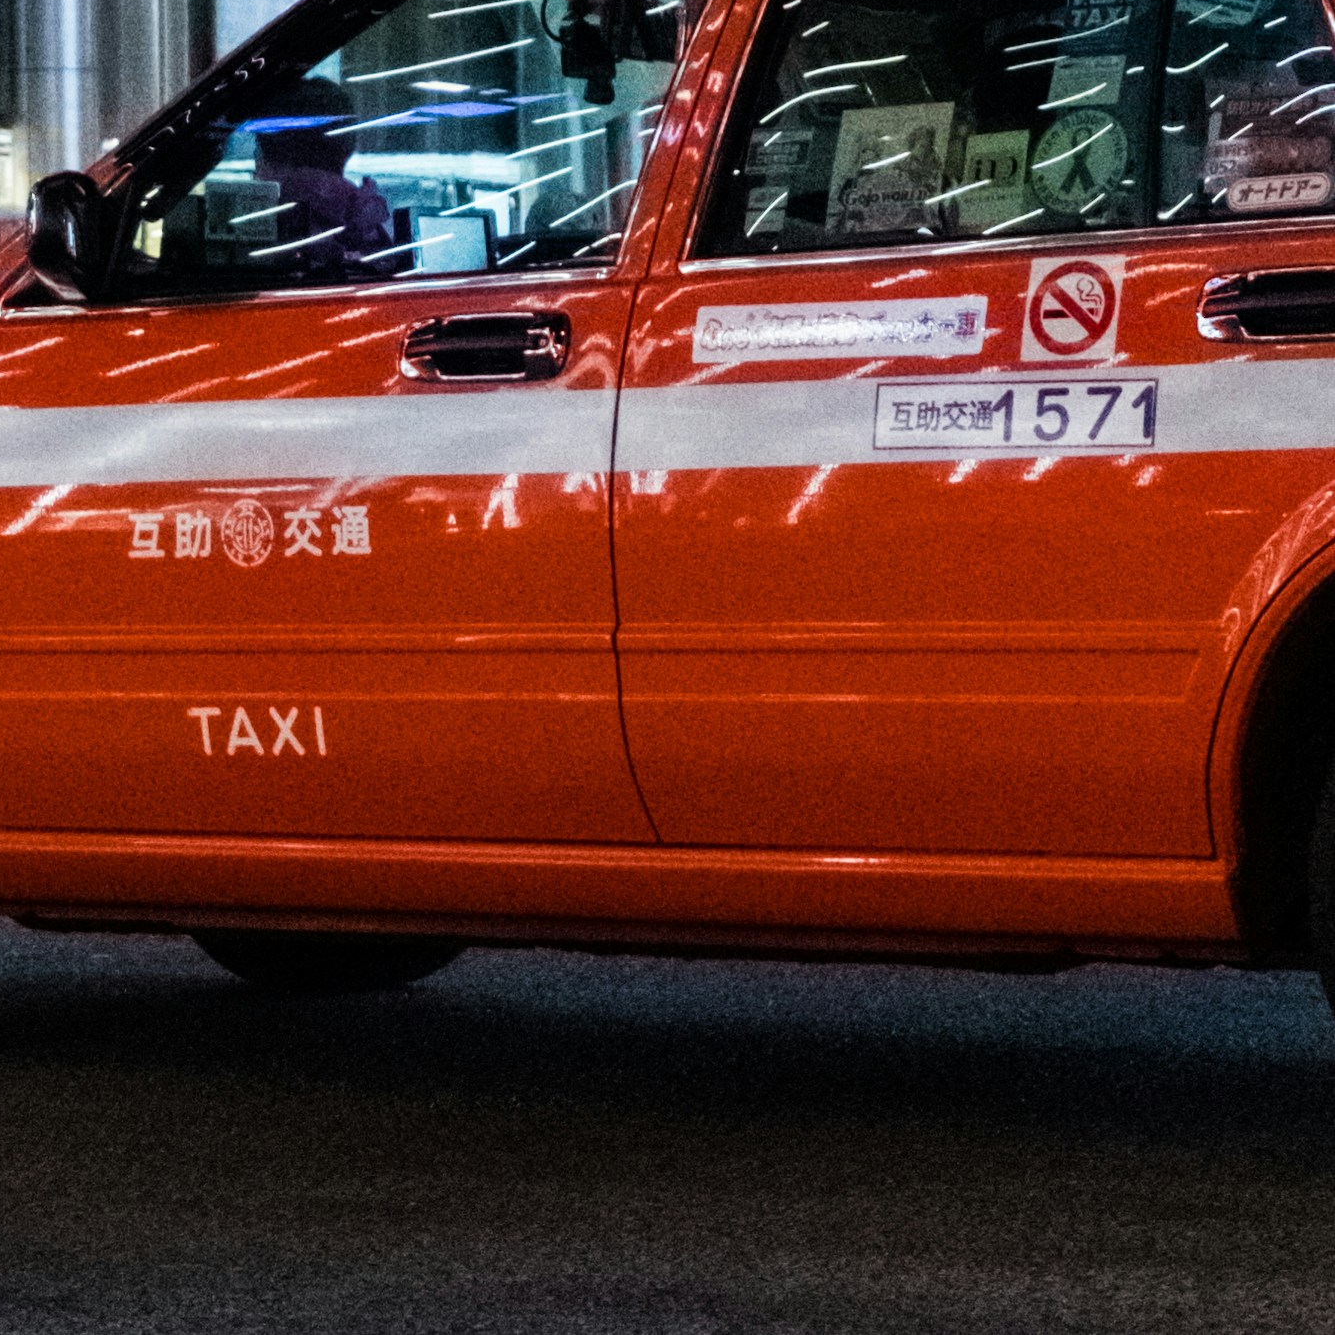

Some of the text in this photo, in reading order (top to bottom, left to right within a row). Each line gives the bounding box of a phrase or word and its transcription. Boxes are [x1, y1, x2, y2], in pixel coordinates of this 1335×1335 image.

[1237, 178, 1322, 203] オートドアー
[890, 385, 1156, 442] 互助交通 1571
[127, 504, 372, 559] 互助 交通
[187, 705, 327, 756] TAXI
